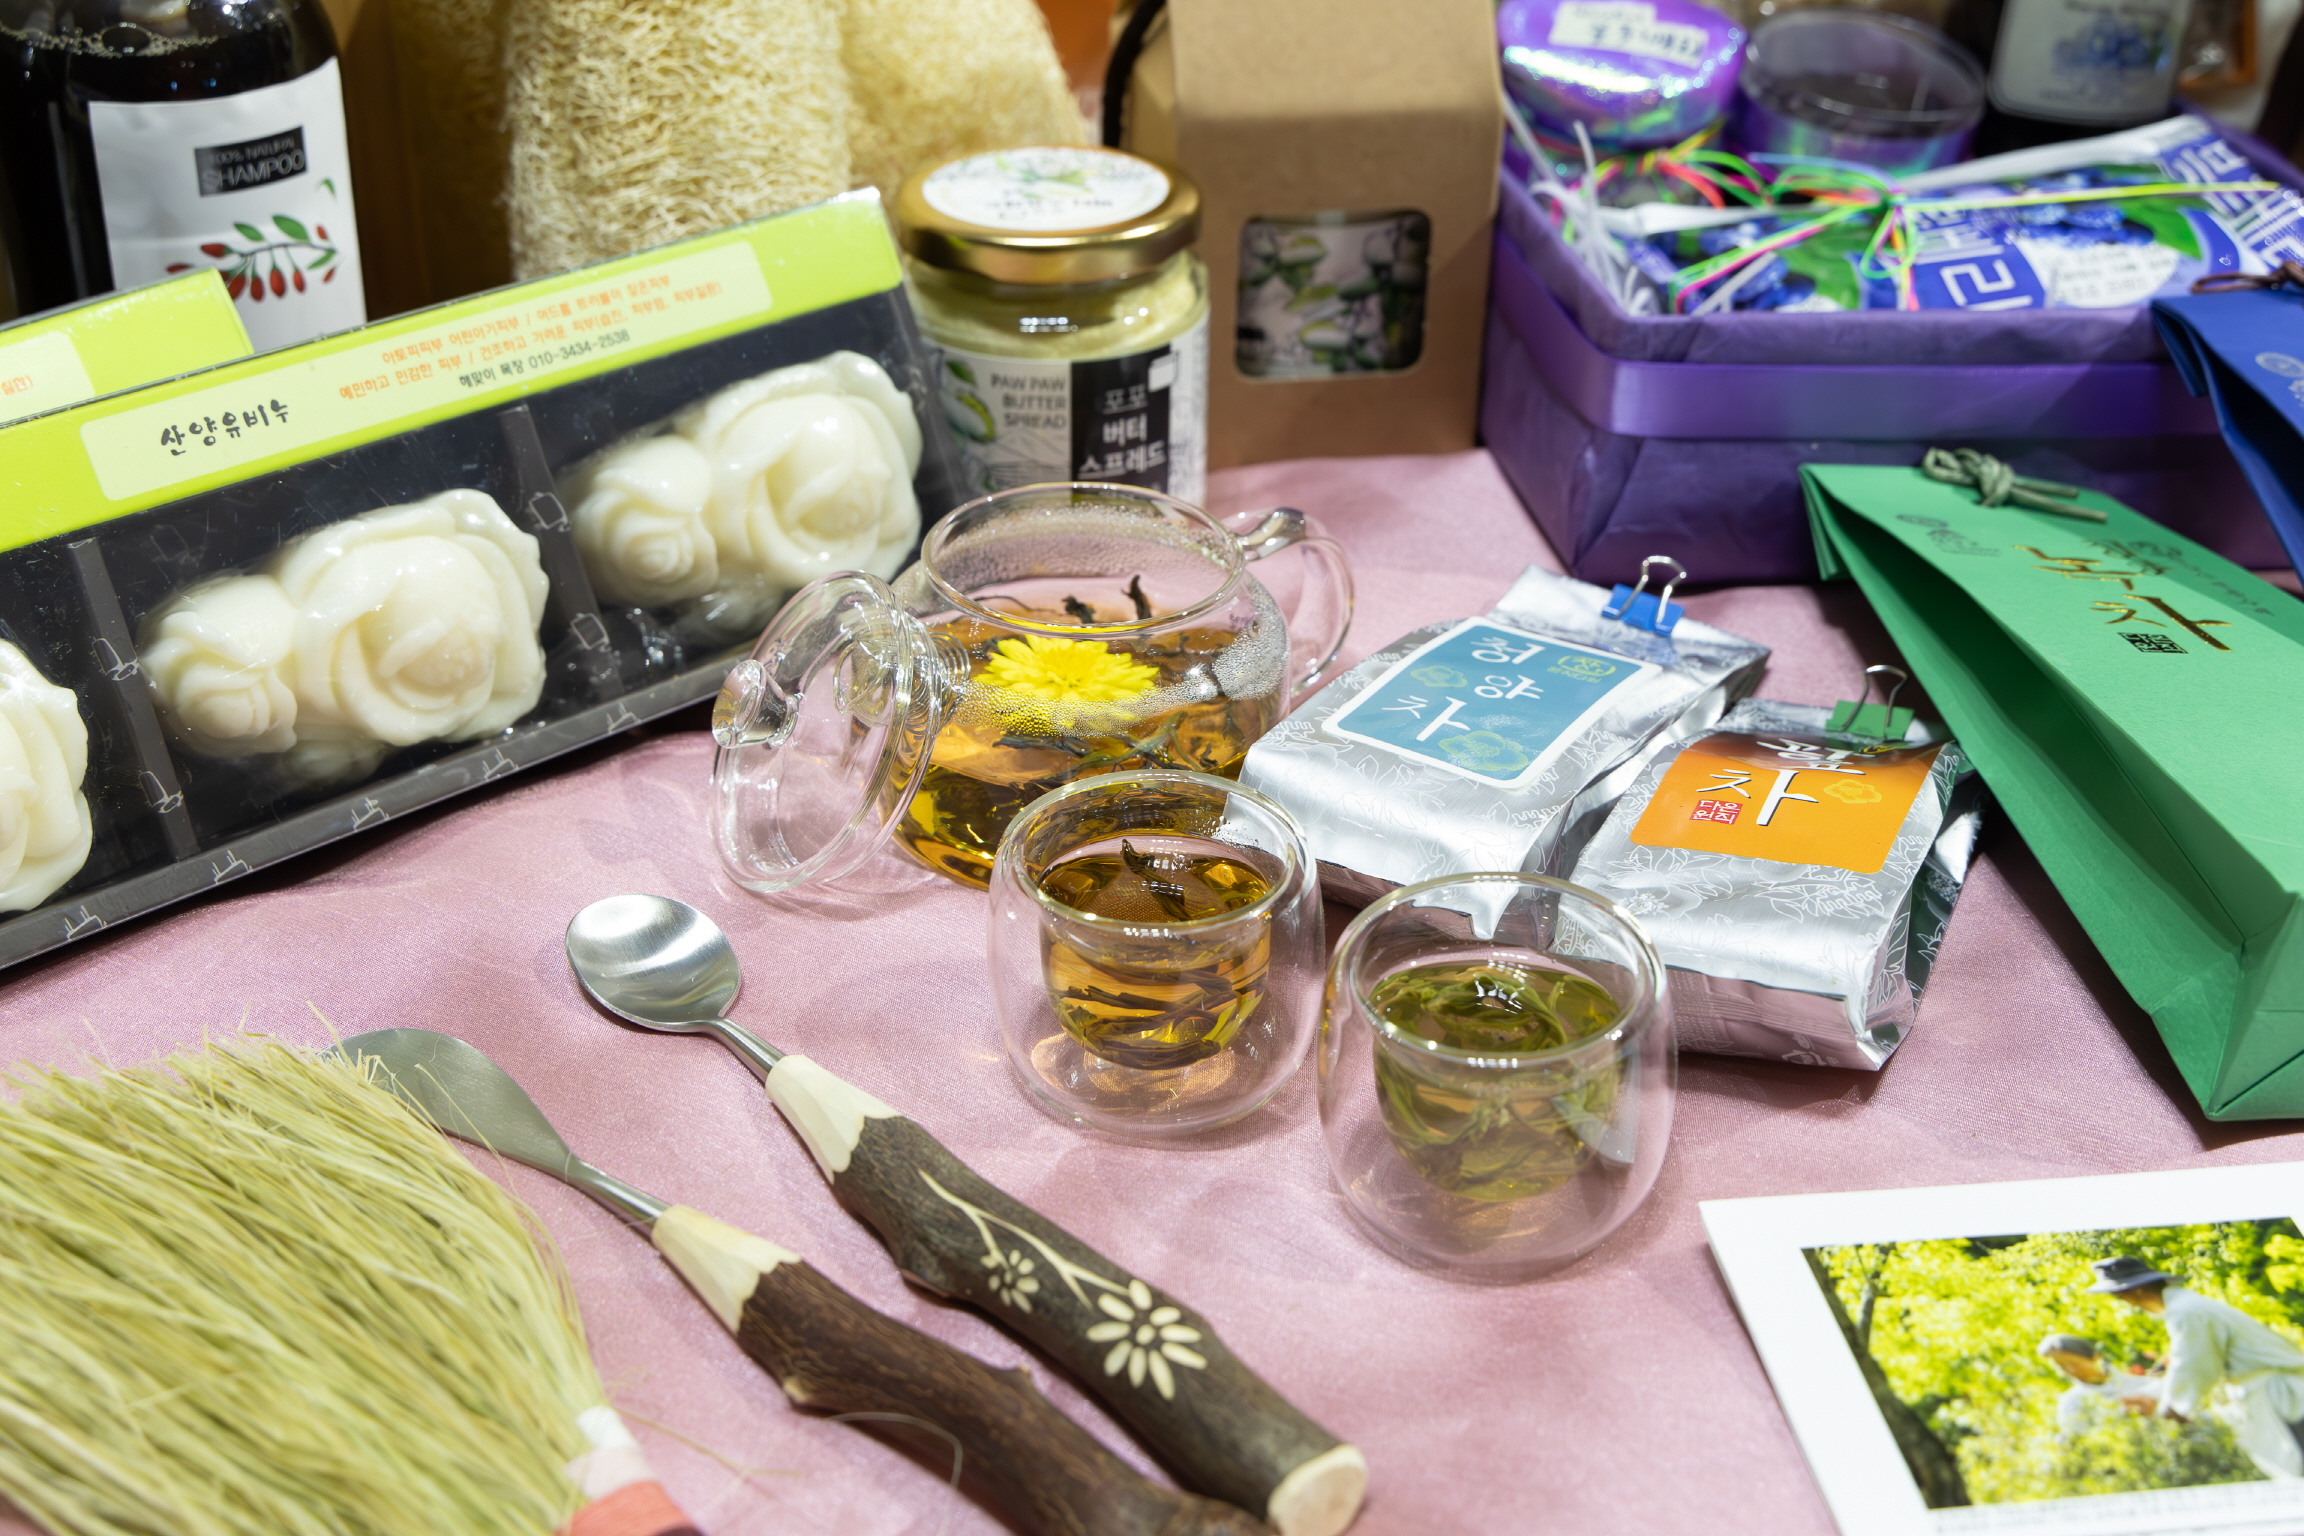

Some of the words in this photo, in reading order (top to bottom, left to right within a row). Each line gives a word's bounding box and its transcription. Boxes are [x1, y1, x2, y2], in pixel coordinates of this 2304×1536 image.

[202, 148, 305, 190] SHAMPOO
[339, 374, 391, 400] 예민하고
[395, 362, 434, 386] 민감한
[437, 353, 463, 371] 피부
[479, 335, 528, 362] 건조하고
[381, 337, 444, 364] 아토피피부
[500, 358, 525, 376] 목장
[528, 328, 631, 369] 010-3434-2538
[991, 373, 1027, 390] PAW
[1030, 375, 1067, 392] PAW
[1002, 392, 1067, 411] BUTTER
[160, 398, 289, 457] 산양유비누
[1003, 412, 1067, 430] SPREAD
[1102, 412, 1148, 448] 버터
[1077, 439, 1167, 480] 스프레드
